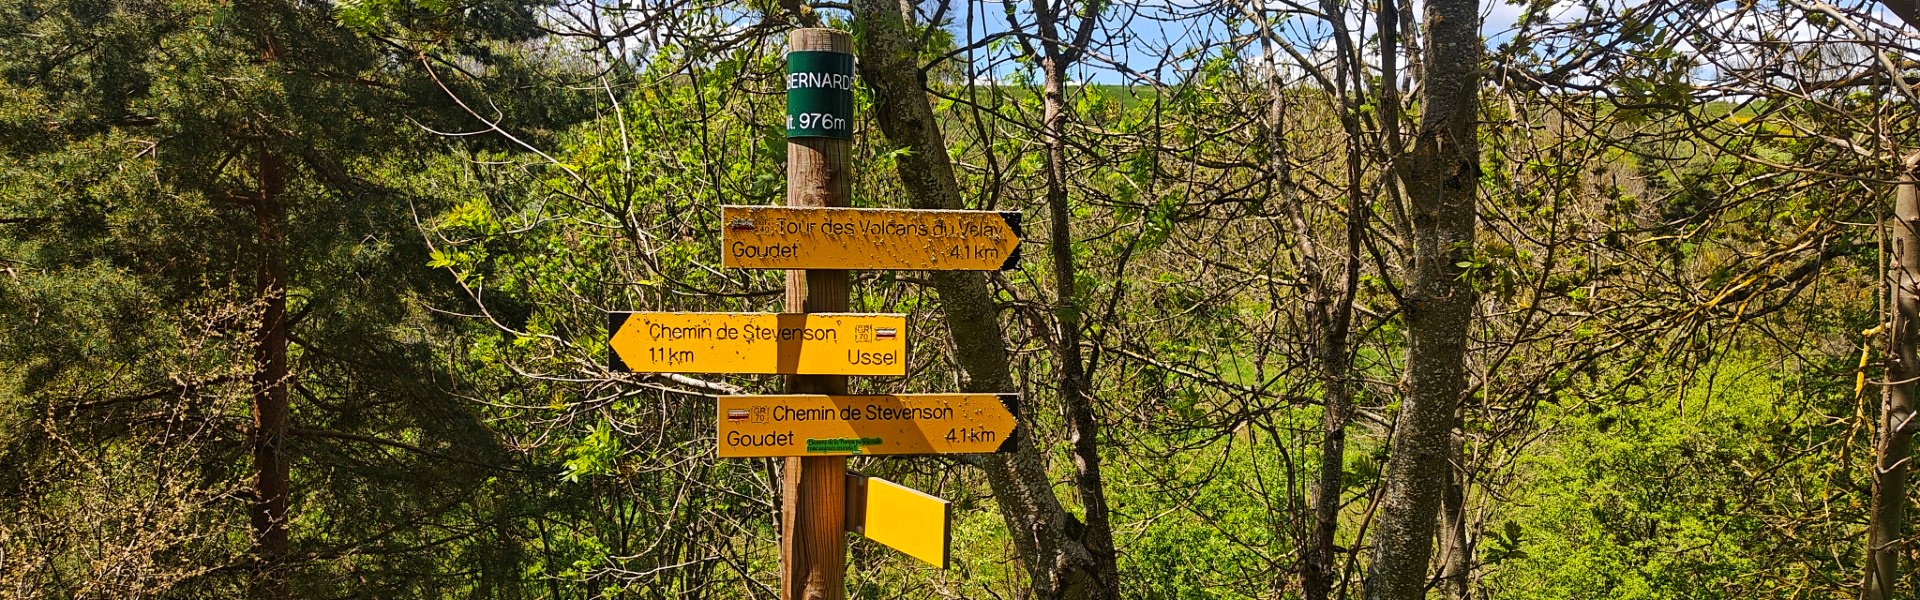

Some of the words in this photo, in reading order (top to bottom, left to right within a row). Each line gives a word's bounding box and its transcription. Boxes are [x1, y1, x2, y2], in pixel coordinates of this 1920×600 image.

[799, 112, 847, 131] 976m
[777, 217, 816, 235] Tour
[821, 219, 855, 236] des
[859, 219, 928, 237] Volcans
[932, 221, 956, 238] du
[958, 221, 1003, 240] Velay
[732, 241, 798, 259] Goudet
[649, 323, 712, 340] Chemin
[717, 324, 738, 340] de
[743, 324, 837, 341] Stevenson
[857, 324, 871, 333] GR
[848, 349, 897, 365] Ussel
[753, 407, 766, 415] GR
[773, 405, 836, 421] Chemin
[840, 405, 861, 421] de
[865, 404, 954, 420] Stevenson
[727, 430, 794, 447] Goudet
